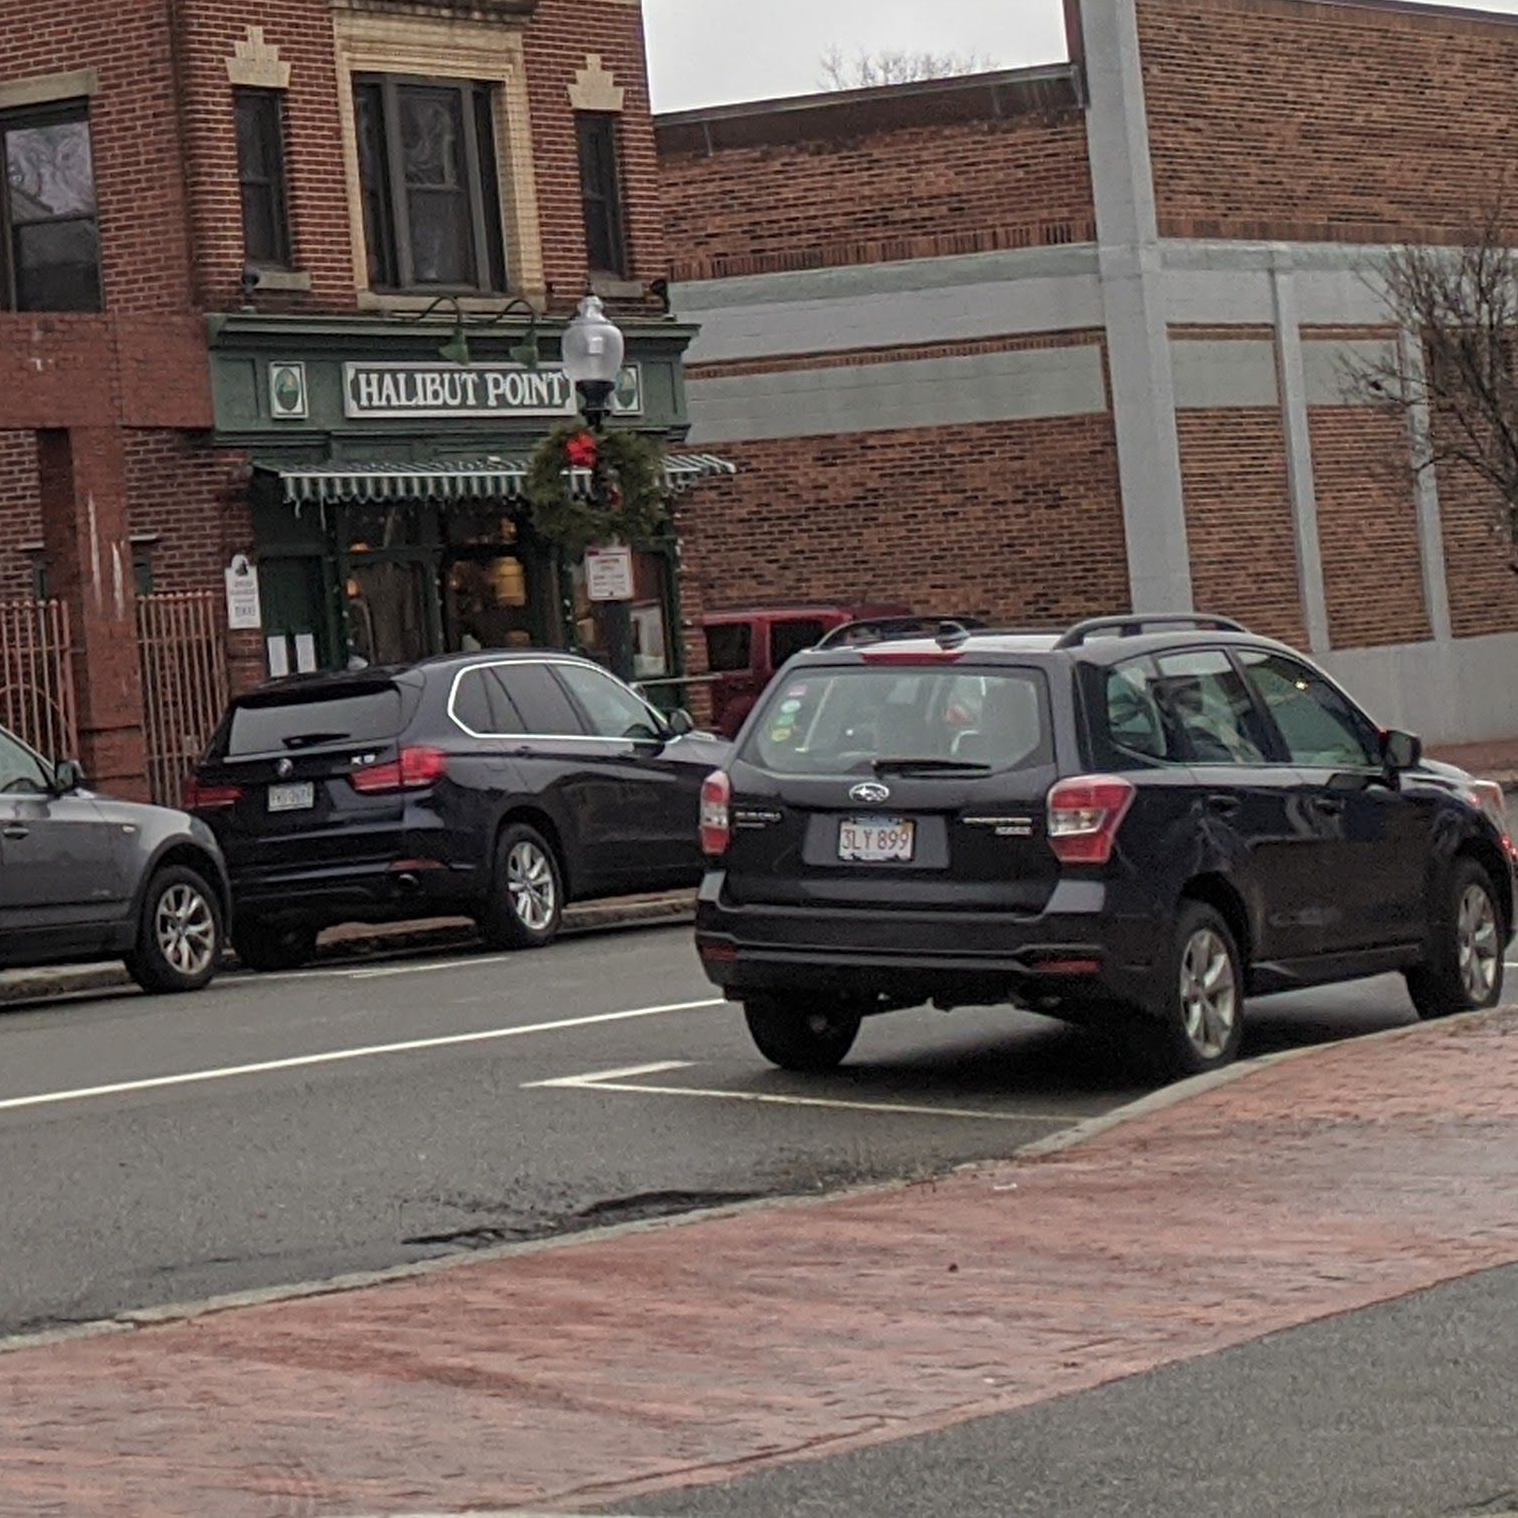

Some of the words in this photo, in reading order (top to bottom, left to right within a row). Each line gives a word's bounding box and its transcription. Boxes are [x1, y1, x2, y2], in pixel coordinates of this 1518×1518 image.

[357, 372, 480, 407] HALIBUT
[484, 371, 564, 407] POINT
[877, 829, 910, 851] 899
